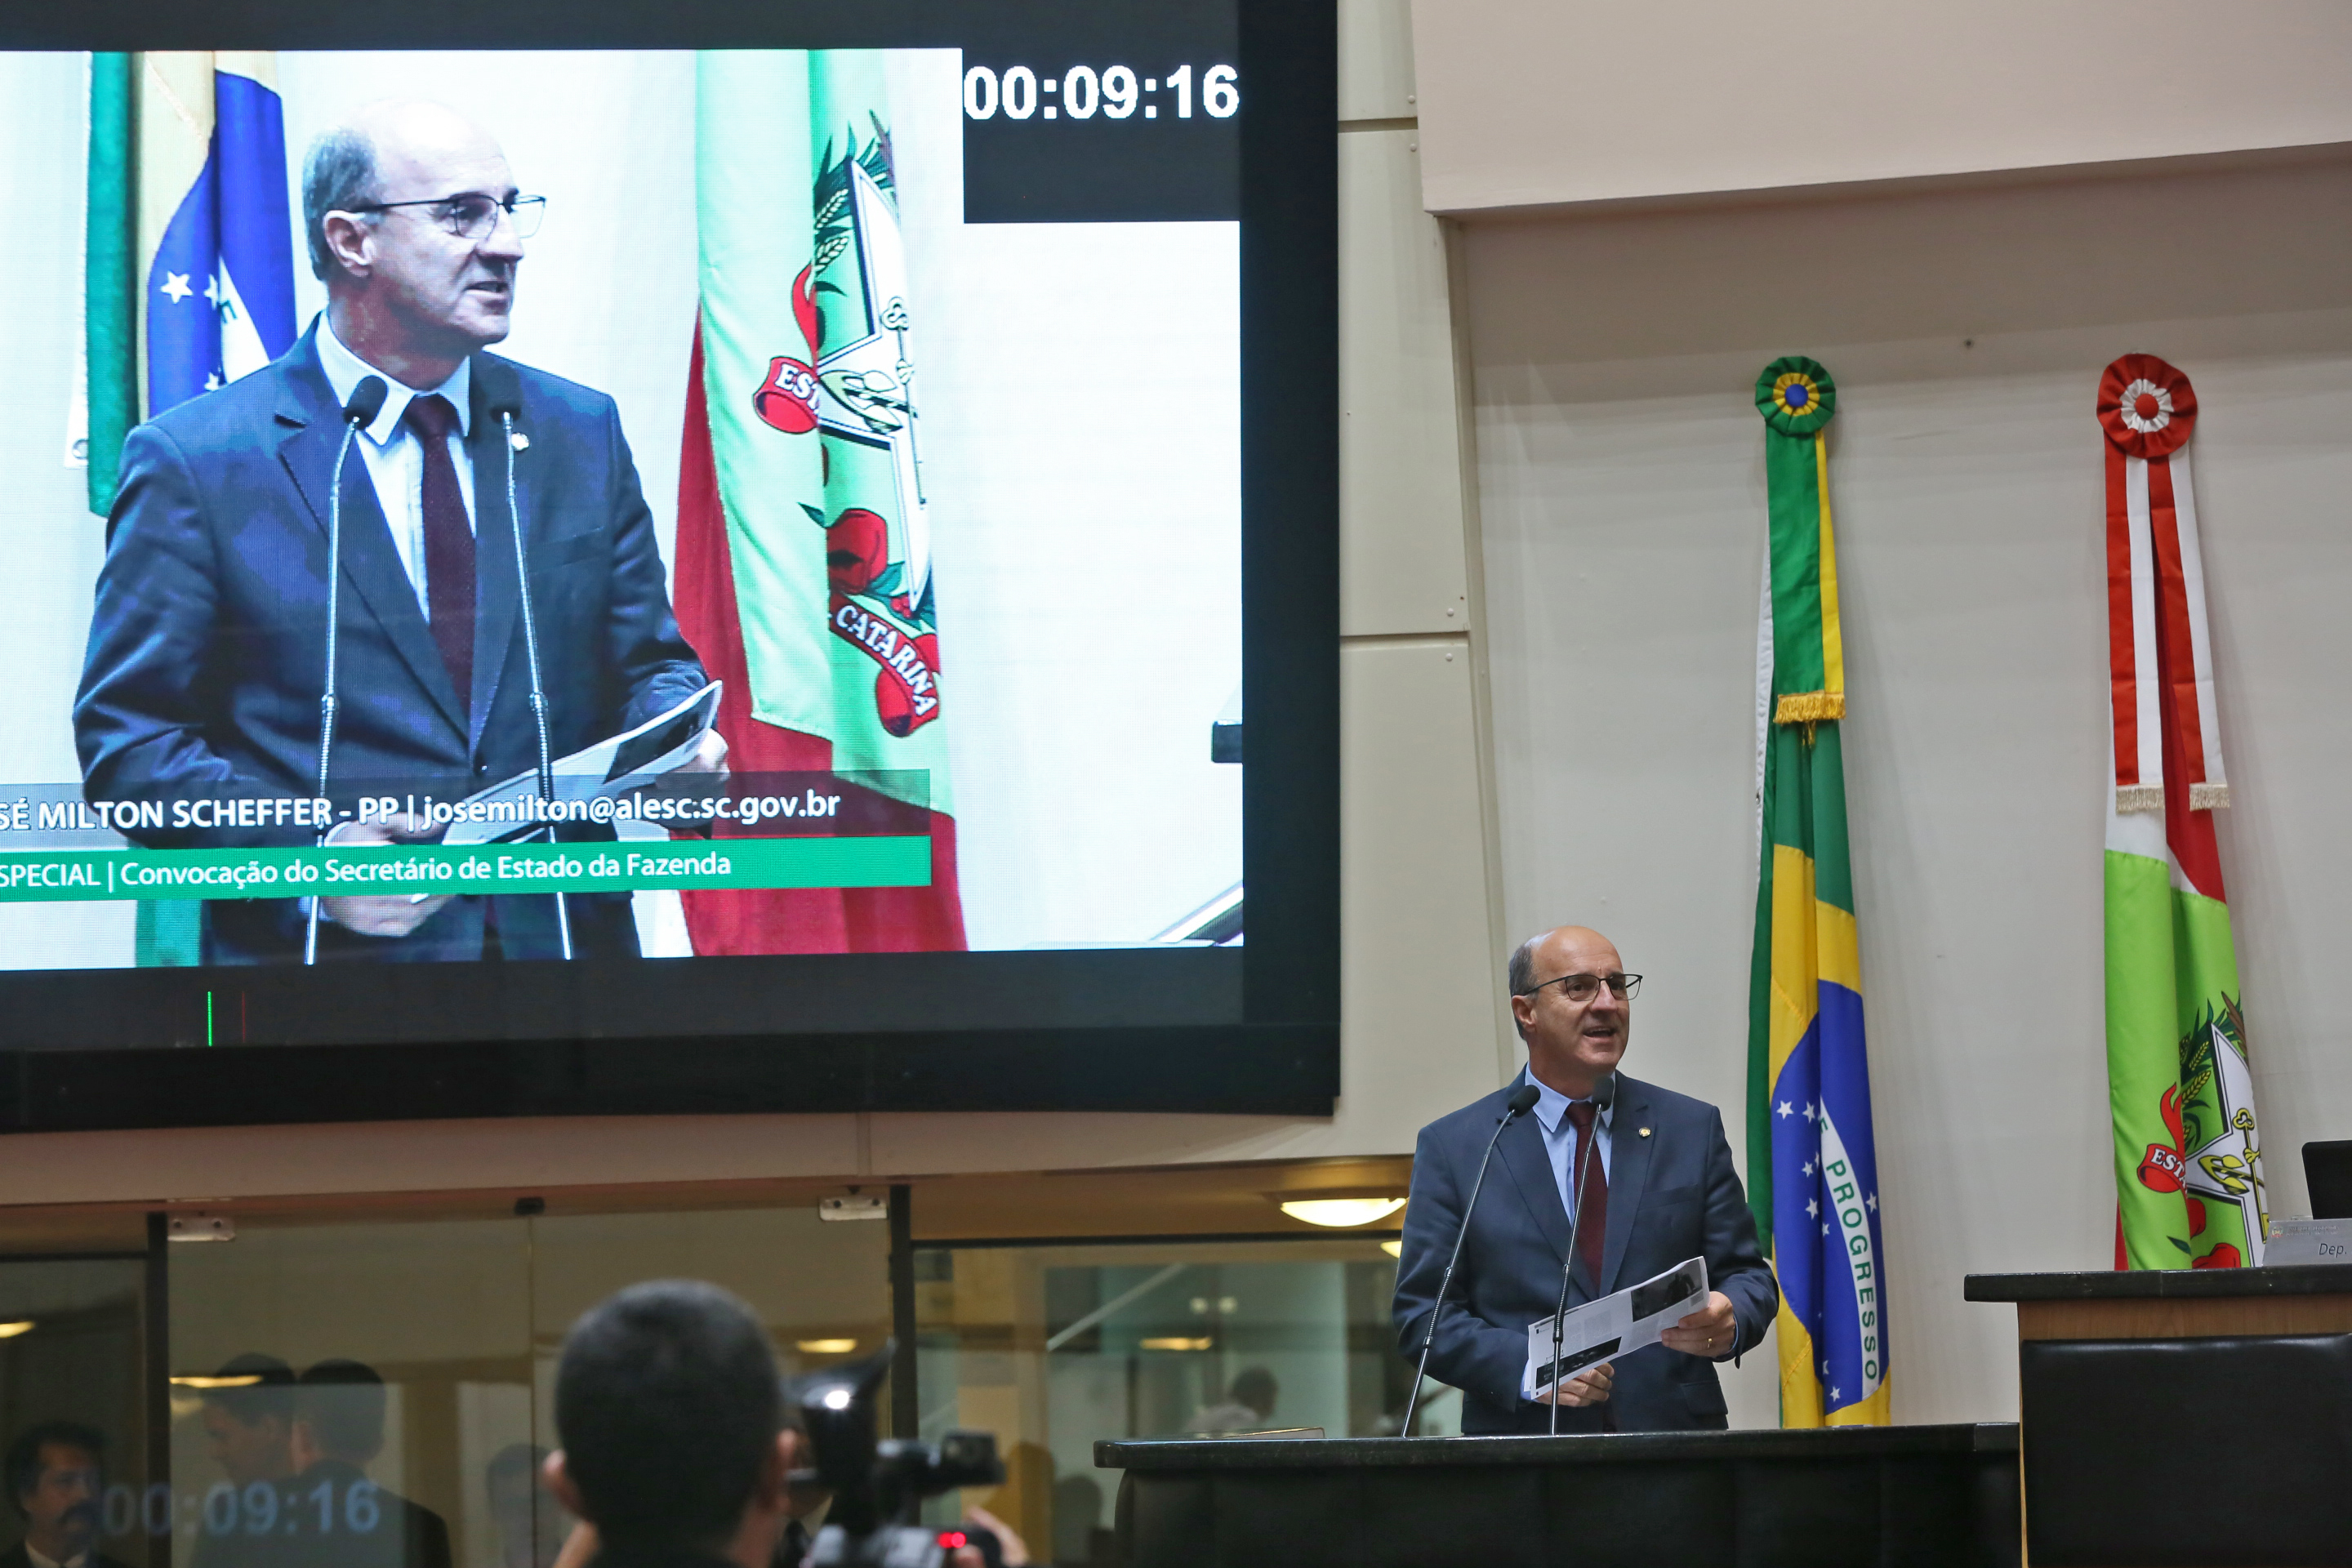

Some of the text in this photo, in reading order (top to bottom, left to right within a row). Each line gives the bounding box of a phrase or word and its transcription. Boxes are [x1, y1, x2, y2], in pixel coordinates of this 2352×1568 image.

[964, 65, 1240, 119] 00:09:16
[836, 605, 938, 715] CATARINA
[38, 800, 163, 830] MILTON
[172, 798, 332, 828] SCHEFFER
[359, 796, 399, 825] PP
[0, 863, 101, 887] SPECIAL
[121, 861, 278, 889] Convocação
[283, 859, 318, 881] do
[325, 856, 452, 881] Secretário
[458, 856, 491, 880] de
[498, 854, 583, 879] Estado
[587, 853, 621, 877] da
[626, 851, 732, 877] Fazenda
[1826, 1160, 1878, 1379] PROGRESSO
[2319, 1243, 2348, 1258] Dep.
